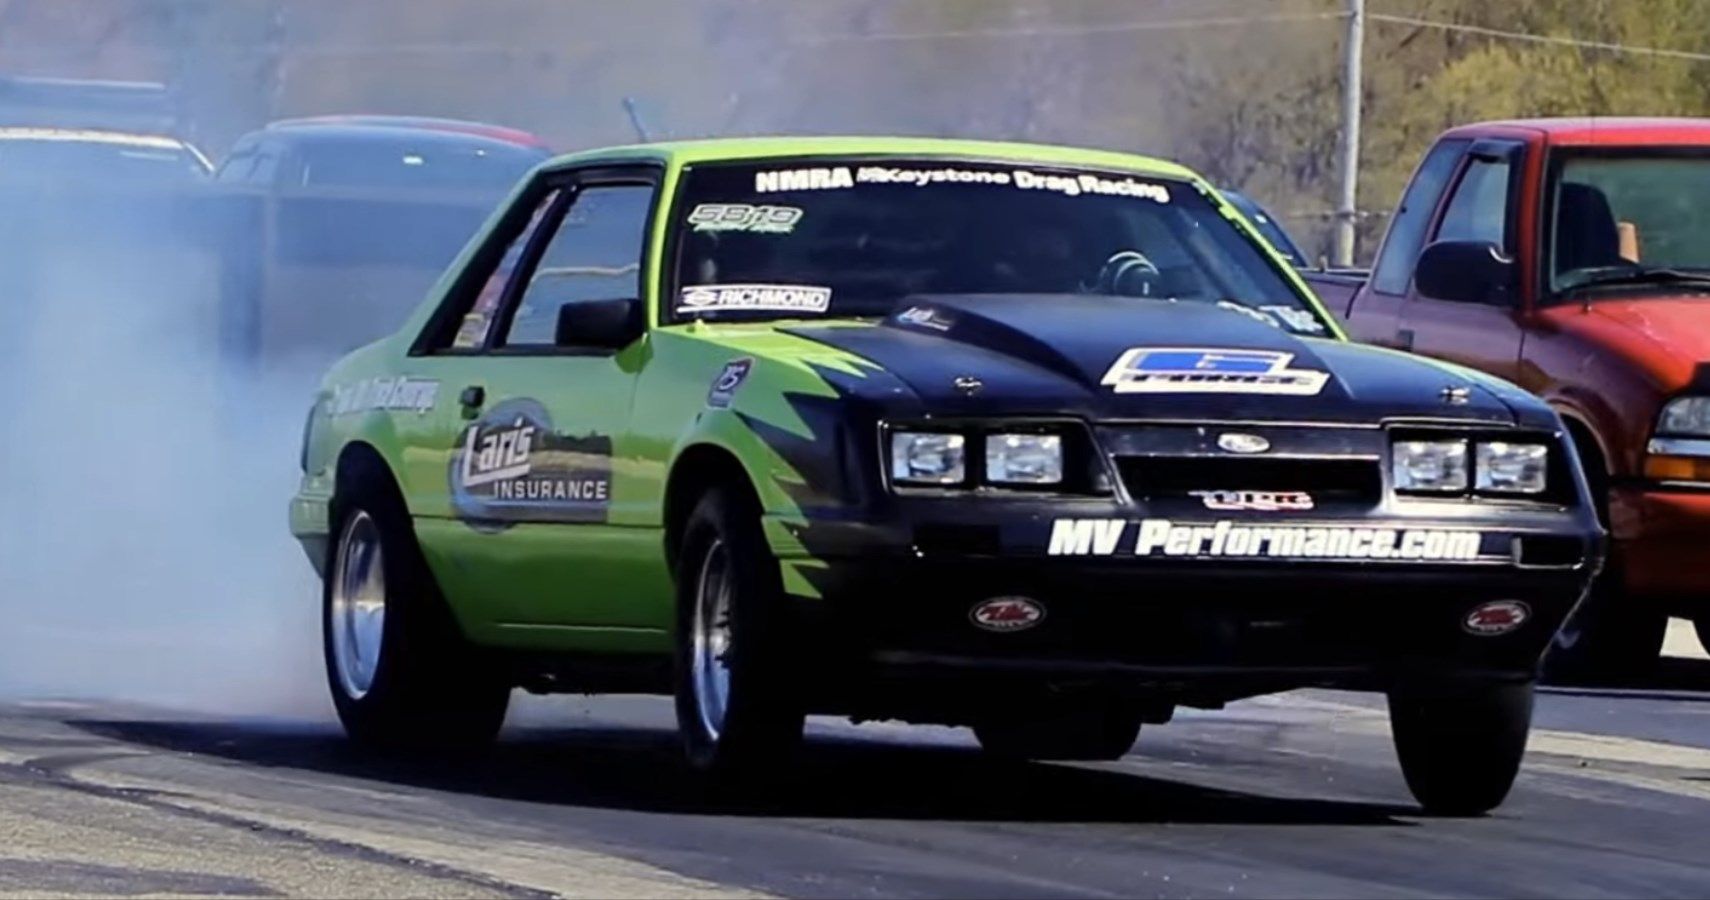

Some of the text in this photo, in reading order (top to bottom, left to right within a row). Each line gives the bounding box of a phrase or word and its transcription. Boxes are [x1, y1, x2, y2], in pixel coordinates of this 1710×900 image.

[755, 167, 853, 193] NMRA
[886, 168, 1011, 186] Keystone
[1013, 170, 1080, 195] Drag
[1079, 175, 1169, 203] Racing
[718, 289, 825, 306] RICHMOND
[493, 479, 608, 500] INSURANCE
[1048, 519, 1481, 560] MV Performance.com
